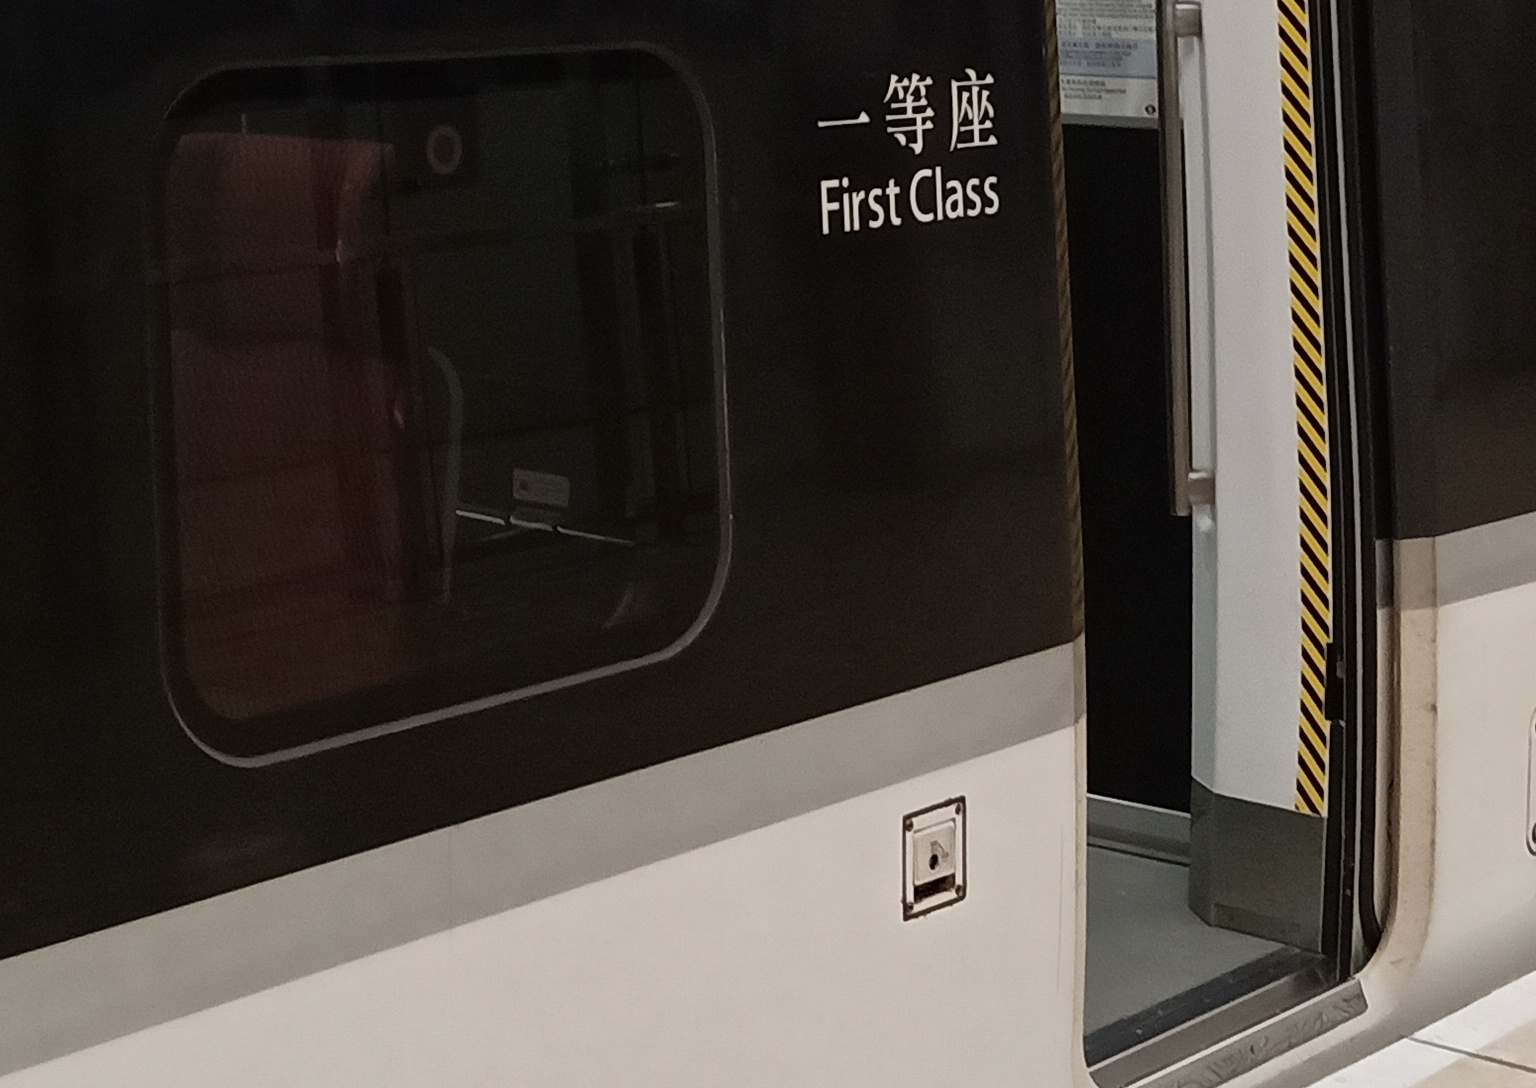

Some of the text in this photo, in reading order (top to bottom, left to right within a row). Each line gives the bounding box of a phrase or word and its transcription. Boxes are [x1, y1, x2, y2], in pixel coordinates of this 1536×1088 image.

[817, 67, 999, 155] 一等座
[820, 165, 1000, 235] First Class
